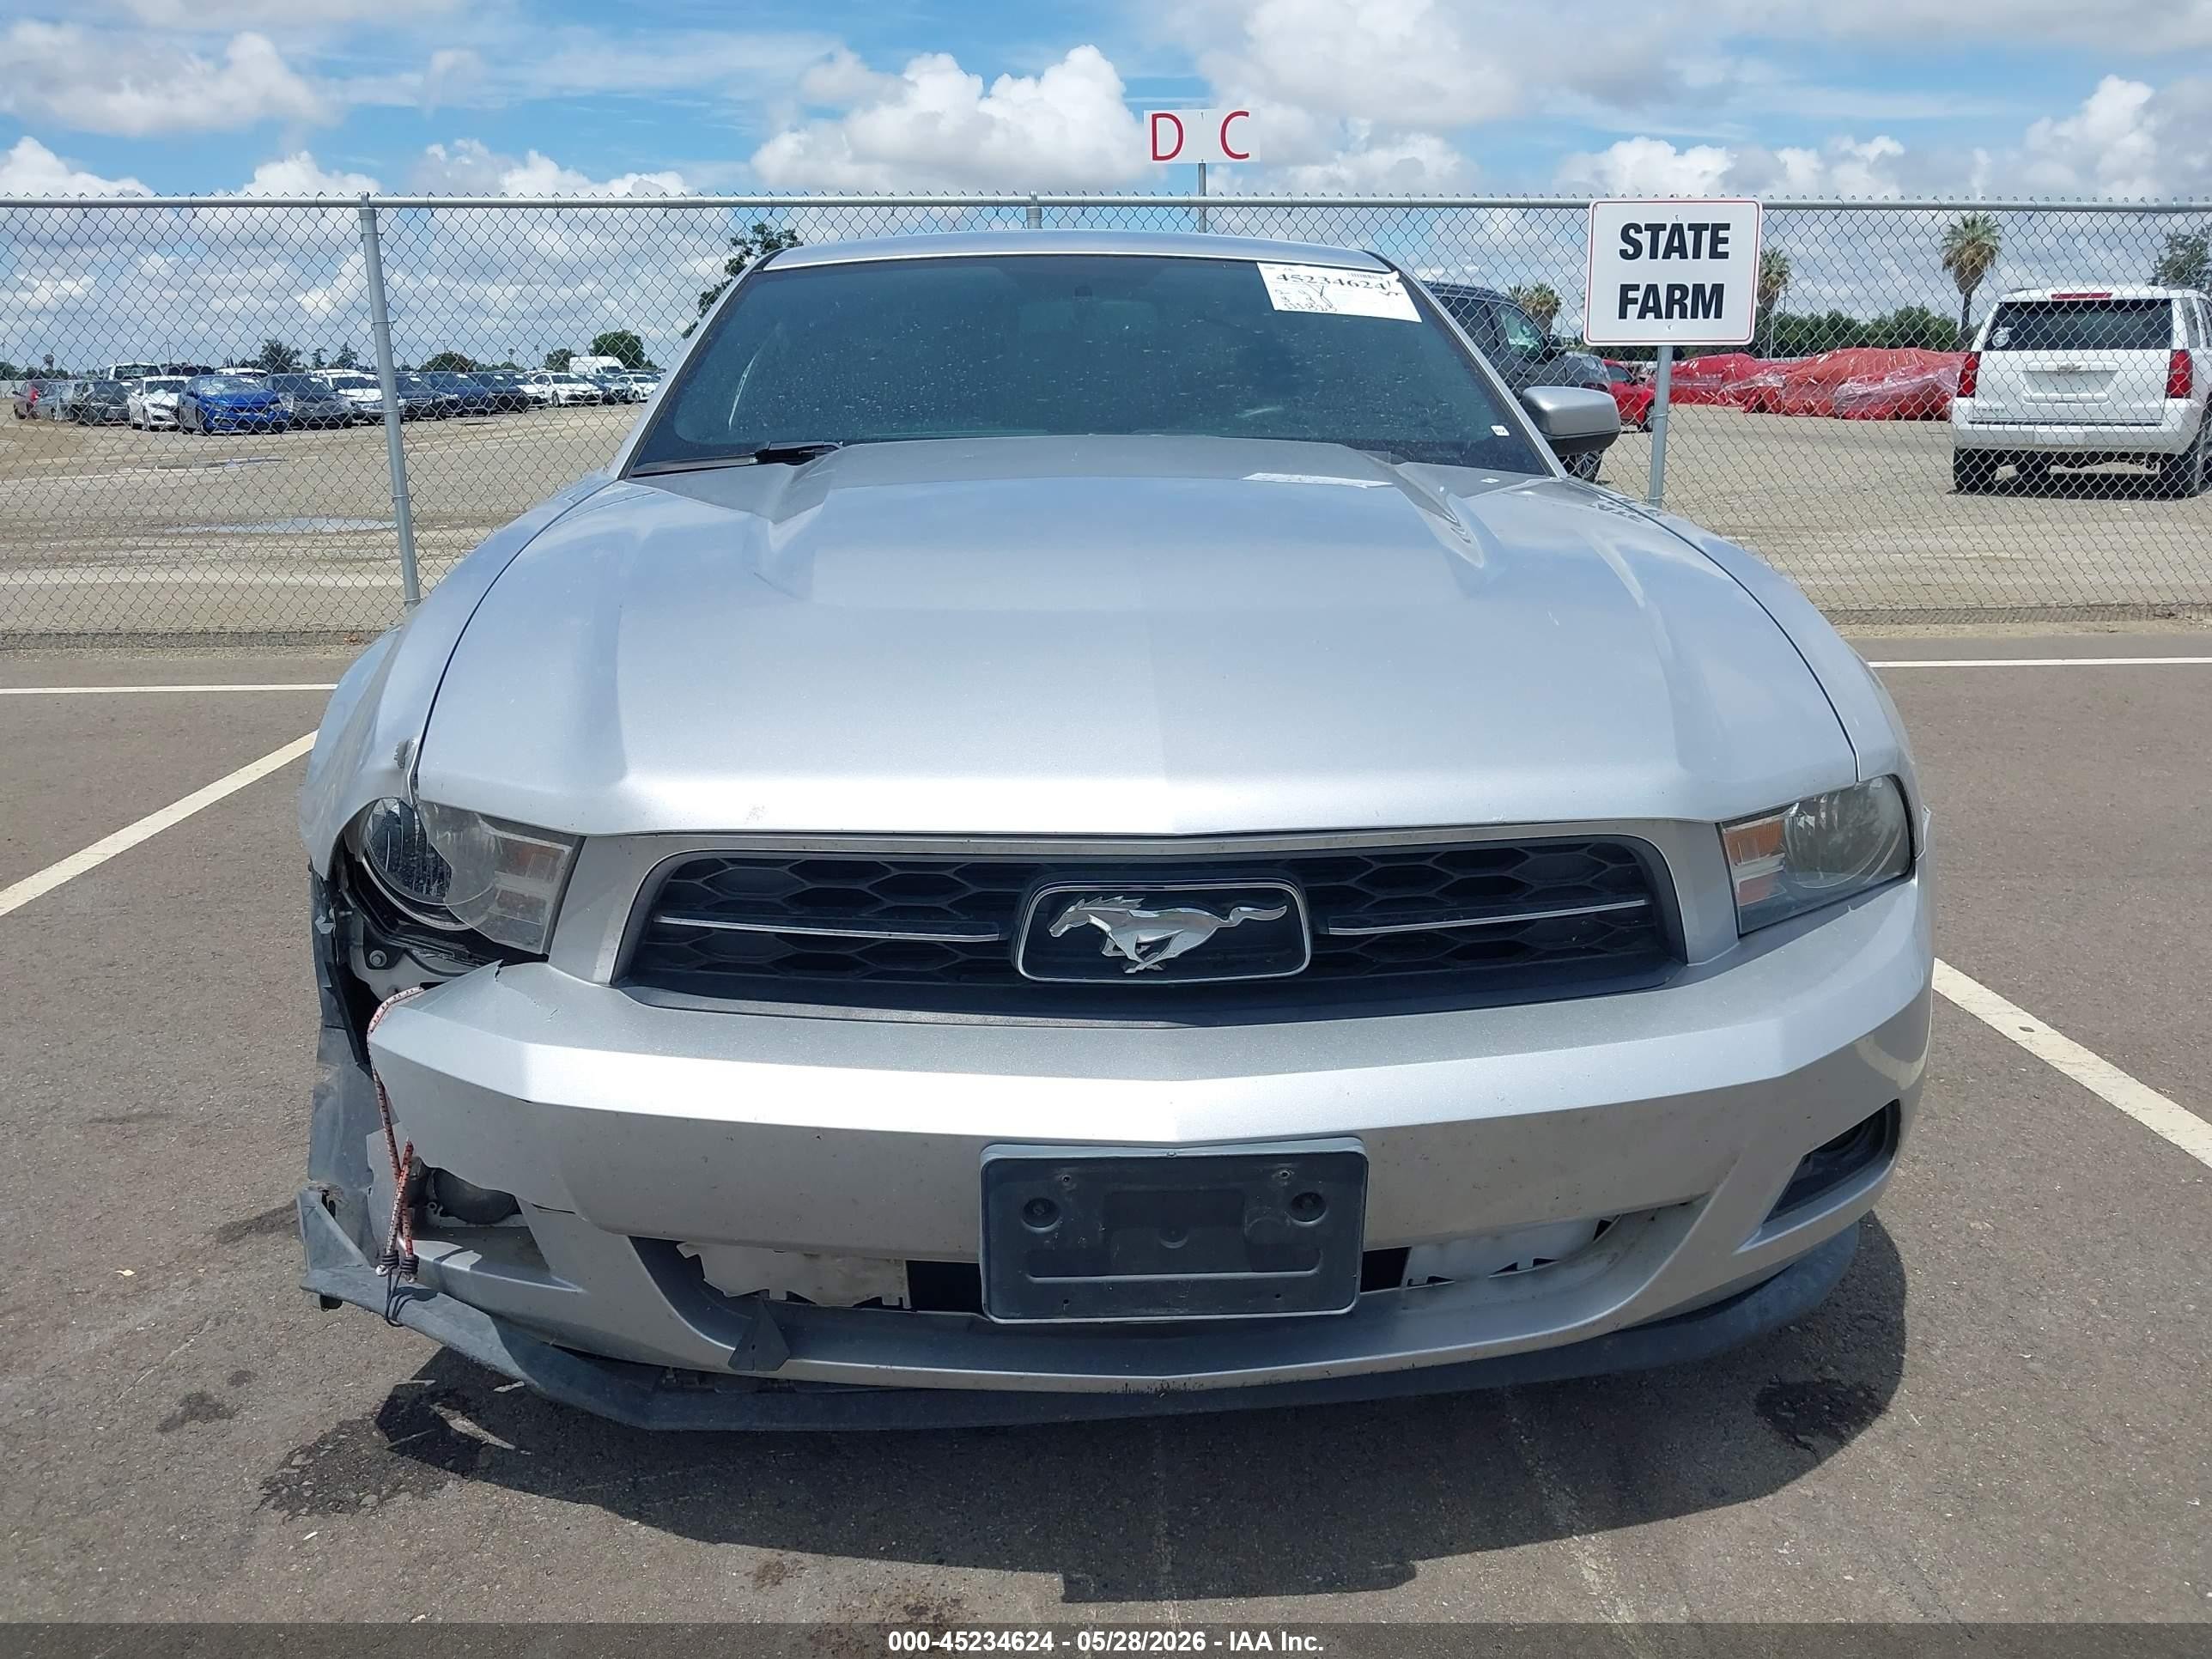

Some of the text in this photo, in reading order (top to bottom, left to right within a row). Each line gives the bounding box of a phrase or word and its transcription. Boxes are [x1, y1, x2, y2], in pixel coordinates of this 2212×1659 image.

[1152, 111, 1249, 161] D C
[1619, 222, 1731, 261] STATE
[1618, 283, 1725, 319] FARM
